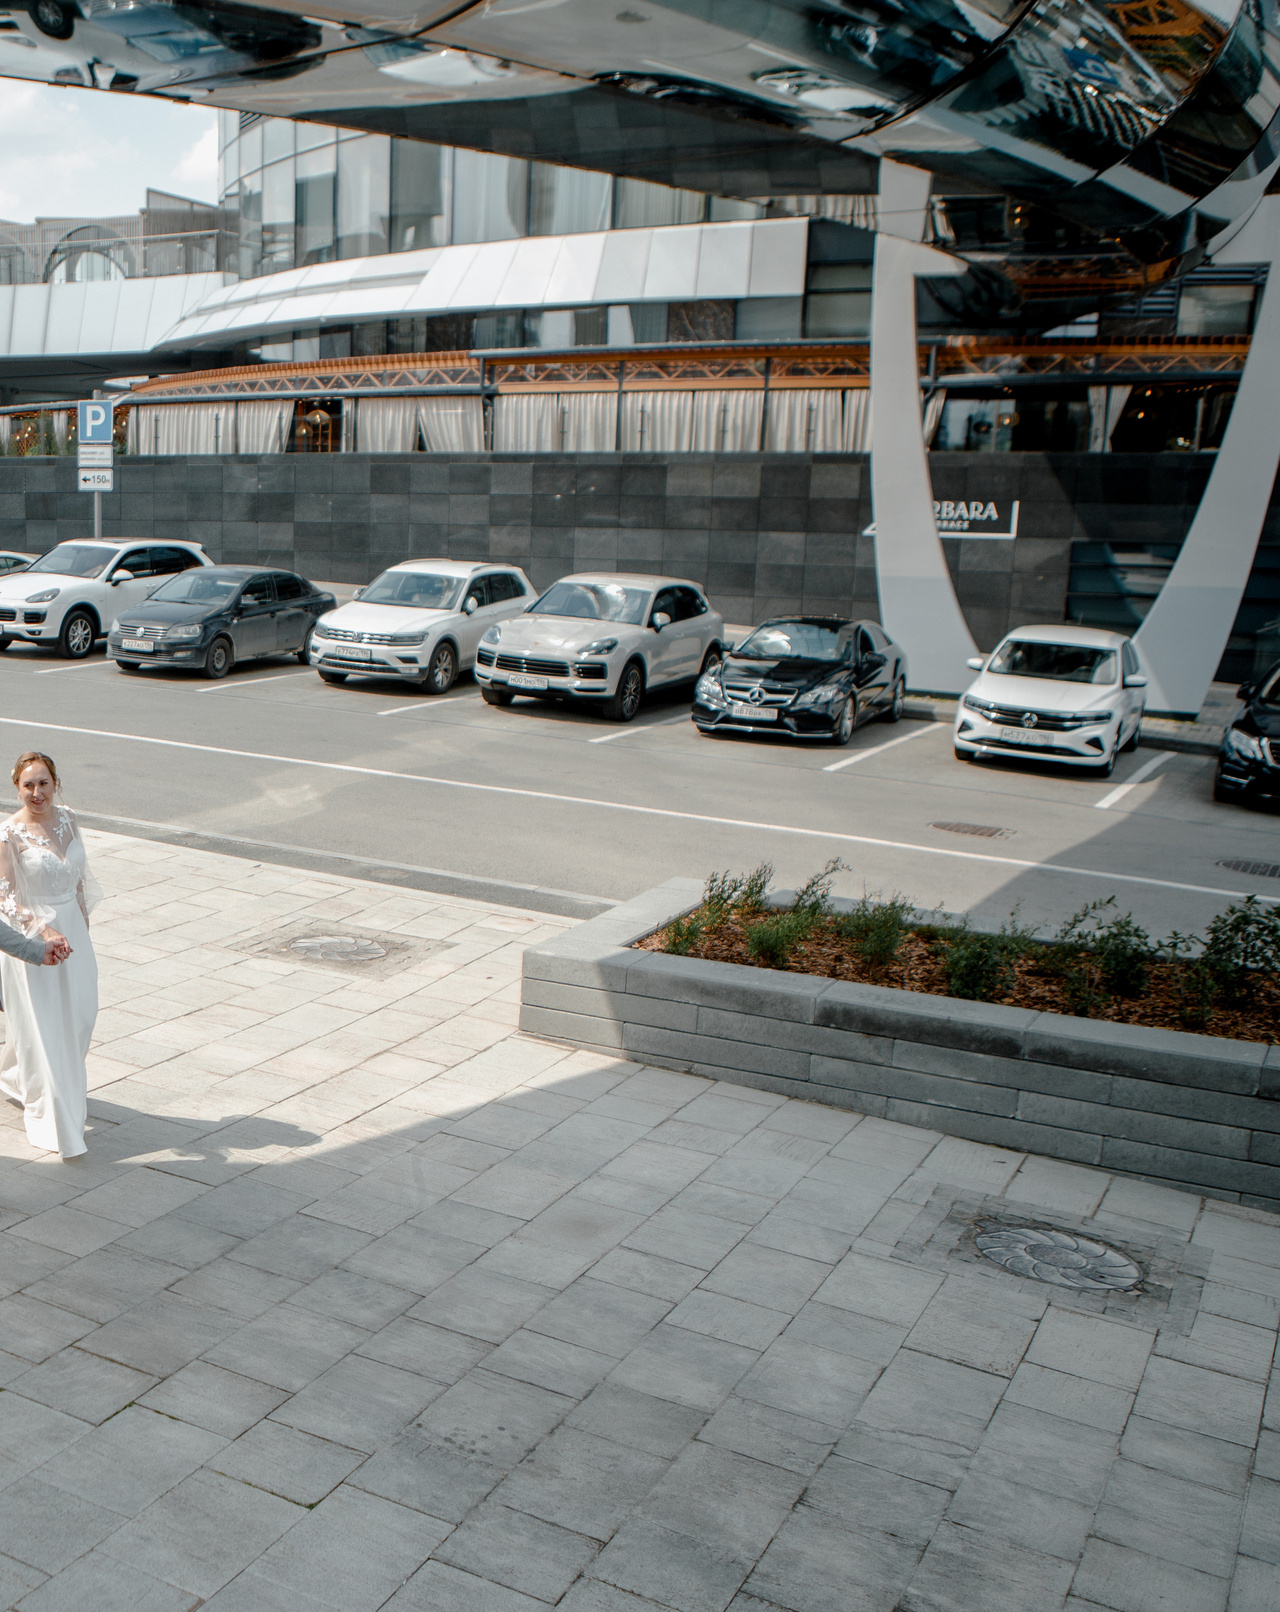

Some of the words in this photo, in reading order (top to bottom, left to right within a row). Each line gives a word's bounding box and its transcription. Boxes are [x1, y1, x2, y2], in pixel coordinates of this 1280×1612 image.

[86, 404, 105, 437] P
[932, 500, 999, 521] RBARA
[936, 520, 970, 530] RRACE
